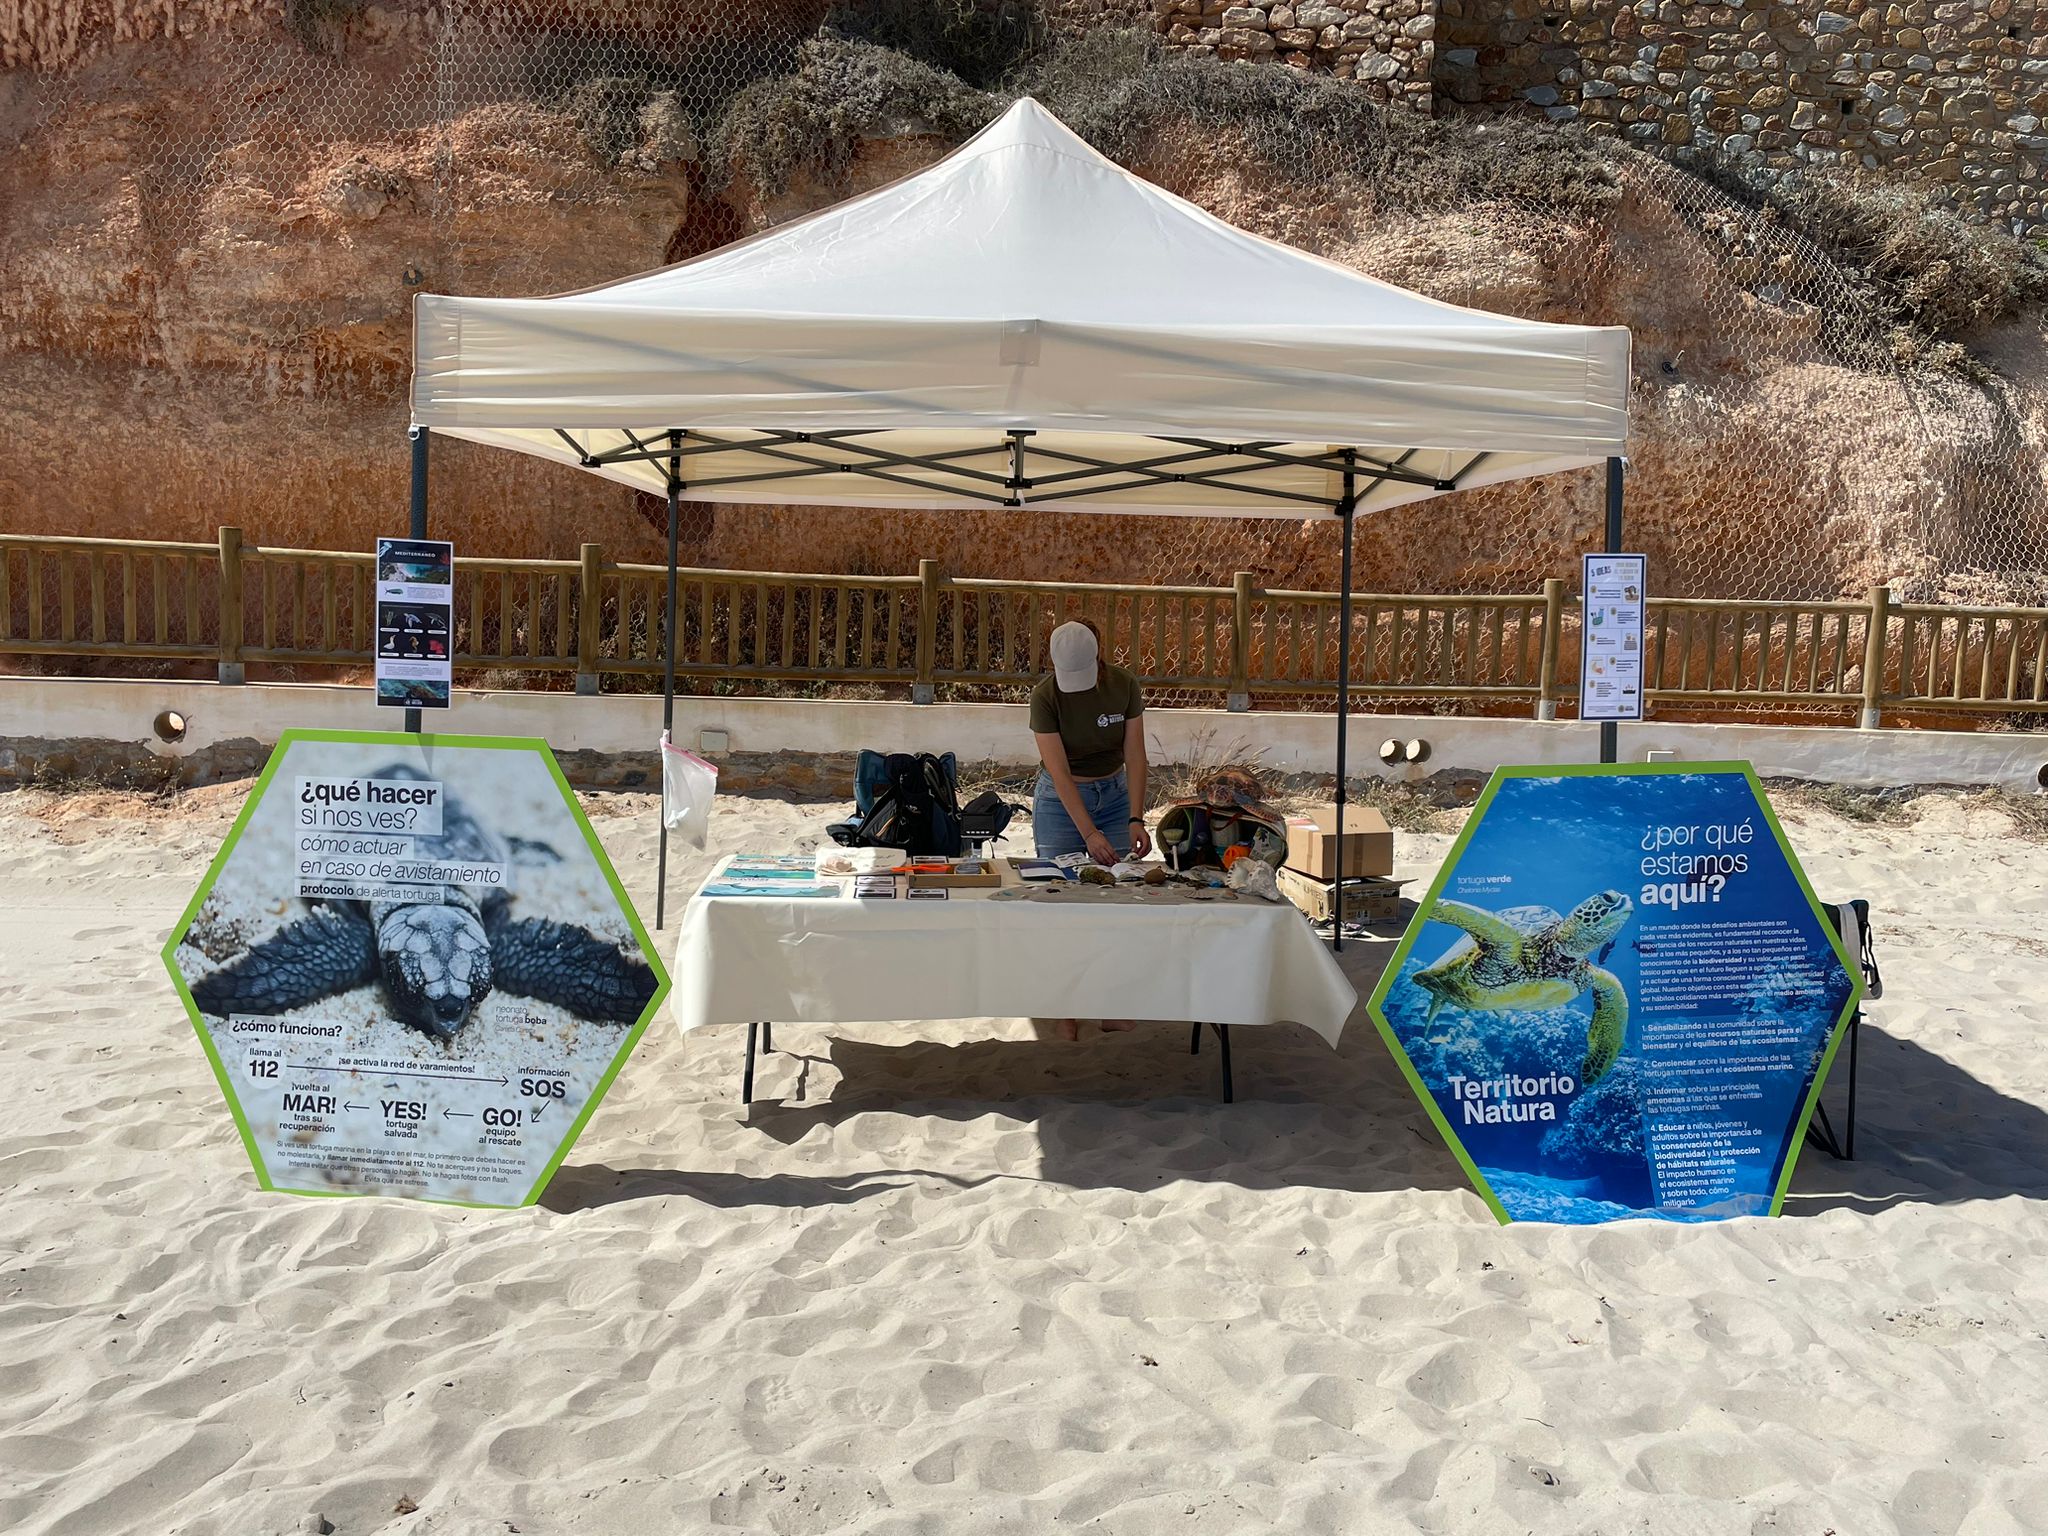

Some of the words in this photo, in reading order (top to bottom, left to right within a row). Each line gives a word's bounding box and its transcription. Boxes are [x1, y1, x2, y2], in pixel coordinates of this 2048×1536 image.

[301, 780, 360, 805] ¿qué
[367, 781, 437, 805] hacer
[301, 804, 317, 825] si
[323, 809, 362, 827] nos
[367, 807, 418, 829] ves?
[1641, 825, 1700, 851] ¿por
[1705, 817, 1753, 850] qué
[301, 835, 350, 852] cómo
[352, 839, 407, 855] actuar
[1641, 852, 1748, 876] estamos
[300, 860, 321, 874] en
[325, 862, 366, 876] caso
[369, 861, 392, 878] de
[394, 863, 500, 883] avistamiento
[1457, 877, 1486, 885] tortuga
[1486, 875, 1512, 883] verde
[300, 884, 354, 897] protocolo
[356, 886, 370, 897] de
[372, 887, 401, 899] alerta
[402, 889, 440, 903] tortuga
[1640, 875, 1726, 910] aquí?
[1722, 929, 1761, 937] fundamental
[232, 1020, 276, 1033] ¿cómo
[279, 1022, 343, 1037] funciona?
[1648, 1022, 1702, 1032] Sensibilizando
[1716, 1020, 1756, 1029] comunidad
[1642, 1032, 1684, 1042] importancia
[1741, 1028, 1776, 1036] naturales
[1642, 1042, 1678, 1050] bienestar
[1692, 1039, 1728, 1049] equilibrio
[250, 1048, 272, 1057] llama
[249, 1060, 278, 1078] 112
[353, 1058, 379, 1067] activa
[380, 1059, 388, 1067] la
[390, 1060, 405, 1069] red
[406, 1061, 418, 1070] de
[419, 1064, 475, 1074] varamientos!
[518, 1067, 570, 1076] información
[520, 1078, 566, 1098] SOS
[1448, 1072, 1574, 1100] Territorio
[1721, 1083, 1760, 1093] principales
[283, 1094, 336, 1114] MAR!
[380, 1100, 427, 1120] YES!
[294, 1113, 310, 1122] tras
[482, 1107, 522, 1127] GO!
[1464, 1100, 1555, 1124] Natura
[279, 1123, 335, 1132] recuperación
[386, 1120, 418, 1130] tortuga
[1714, 1121, 1743, 1130] jóvenes
[384, 1130, 418, 1139] salvada
[486, 1129, 516, 1137] equipo
[1652, 1133, 1679, 1141] adultos
[1679, 1132, 1700, 1140] sobre
[1709, 1129, 1752, 1139] importancia
[488, 1138, 522, 1147] rescate
[1661, 1140, 1712, 1150] conservación
[1654, 1150, 1706, 1160] biodiversidad
[1720, 1146, 1760, 1158] protección
[1667, 1160, 1699, 1169] hábitats
[1666, 1170, 1696, 1179] impacto
[1667, 1179, 1709, 1188] ecosistema
[1710, 1177, 1735, 1185] marino
[1667, 1189, 1688, 1197] sobre
[1708, 1187, 1729, 1195] cómo
